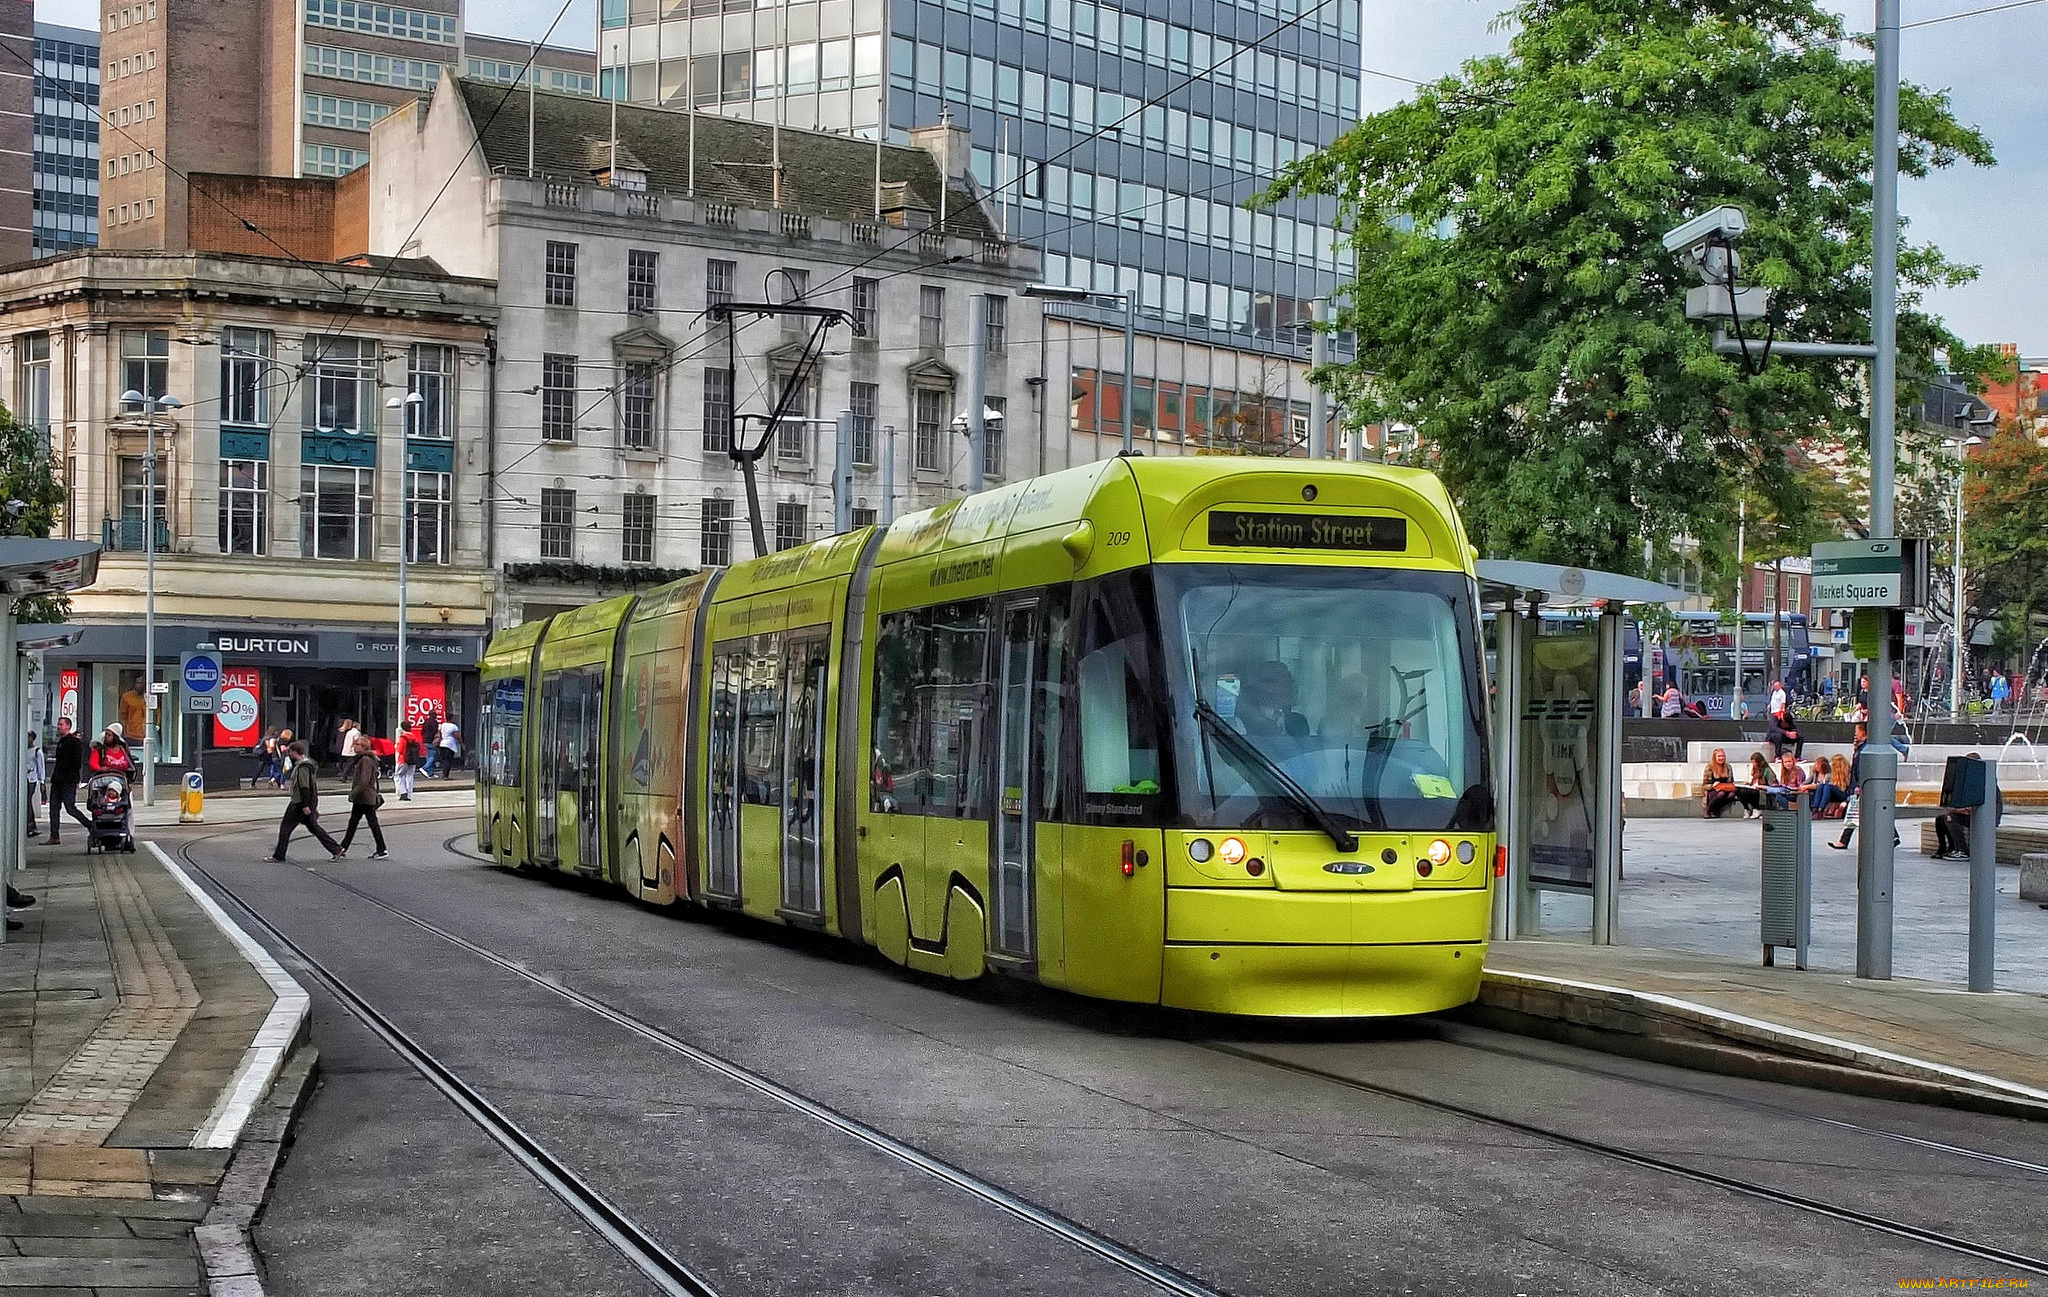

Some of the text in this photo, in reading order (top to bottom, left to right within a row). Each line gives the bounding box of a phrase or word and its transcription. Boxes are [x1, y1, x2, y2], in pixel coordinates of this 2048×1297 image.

[1234, 514, 1374, 545] Station Street
[1106, 531, 1131, 547] 209
[1817, 585, 1845, 599] Market
[1846, 583, 1889, 602] Square
[218, 637, 309, 653] BURTON
[221, 673, 256, 688] SALE
[193, 699, 210, 709] Only
[220, 700, 255, 715] 50%
[407, 697, 443, 715] 50%
